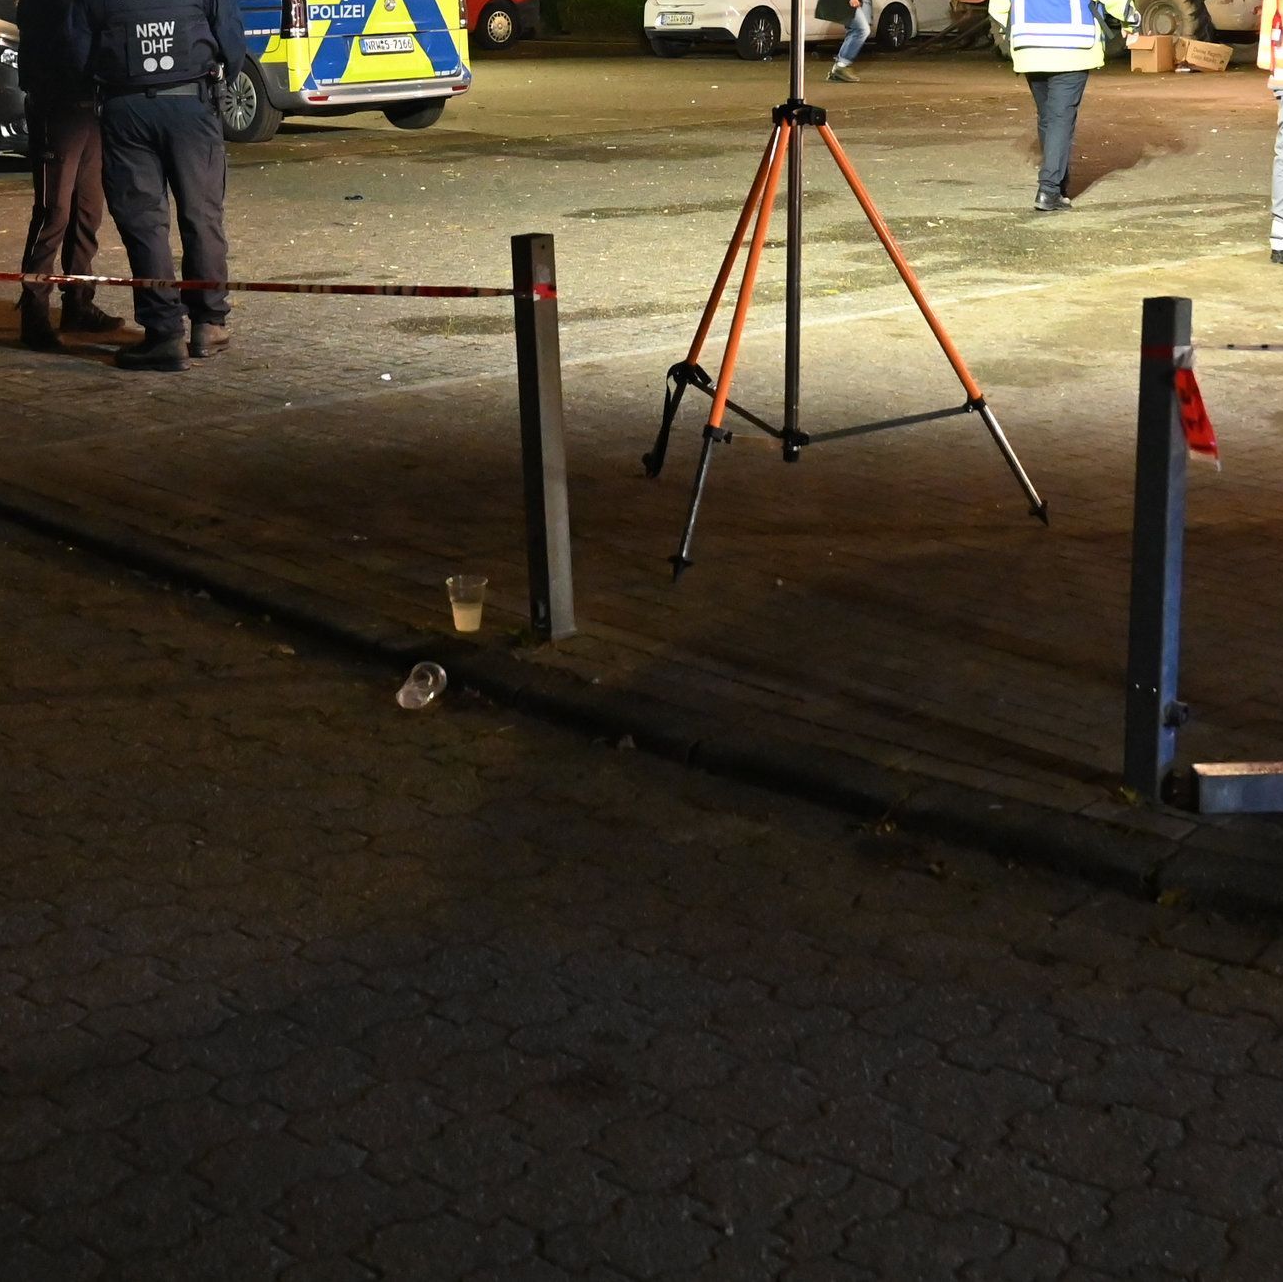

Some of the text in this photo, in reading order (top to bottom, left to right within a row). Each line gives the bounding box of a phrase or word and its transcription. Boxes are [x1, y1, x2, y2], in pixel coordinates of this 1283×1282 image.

[309, 4, 366, 20] POLIZEI
[136, 20, 175, 39] NRW
[141, 37, 174, 55] DHF
[365, 41, 381, 51] NRW
